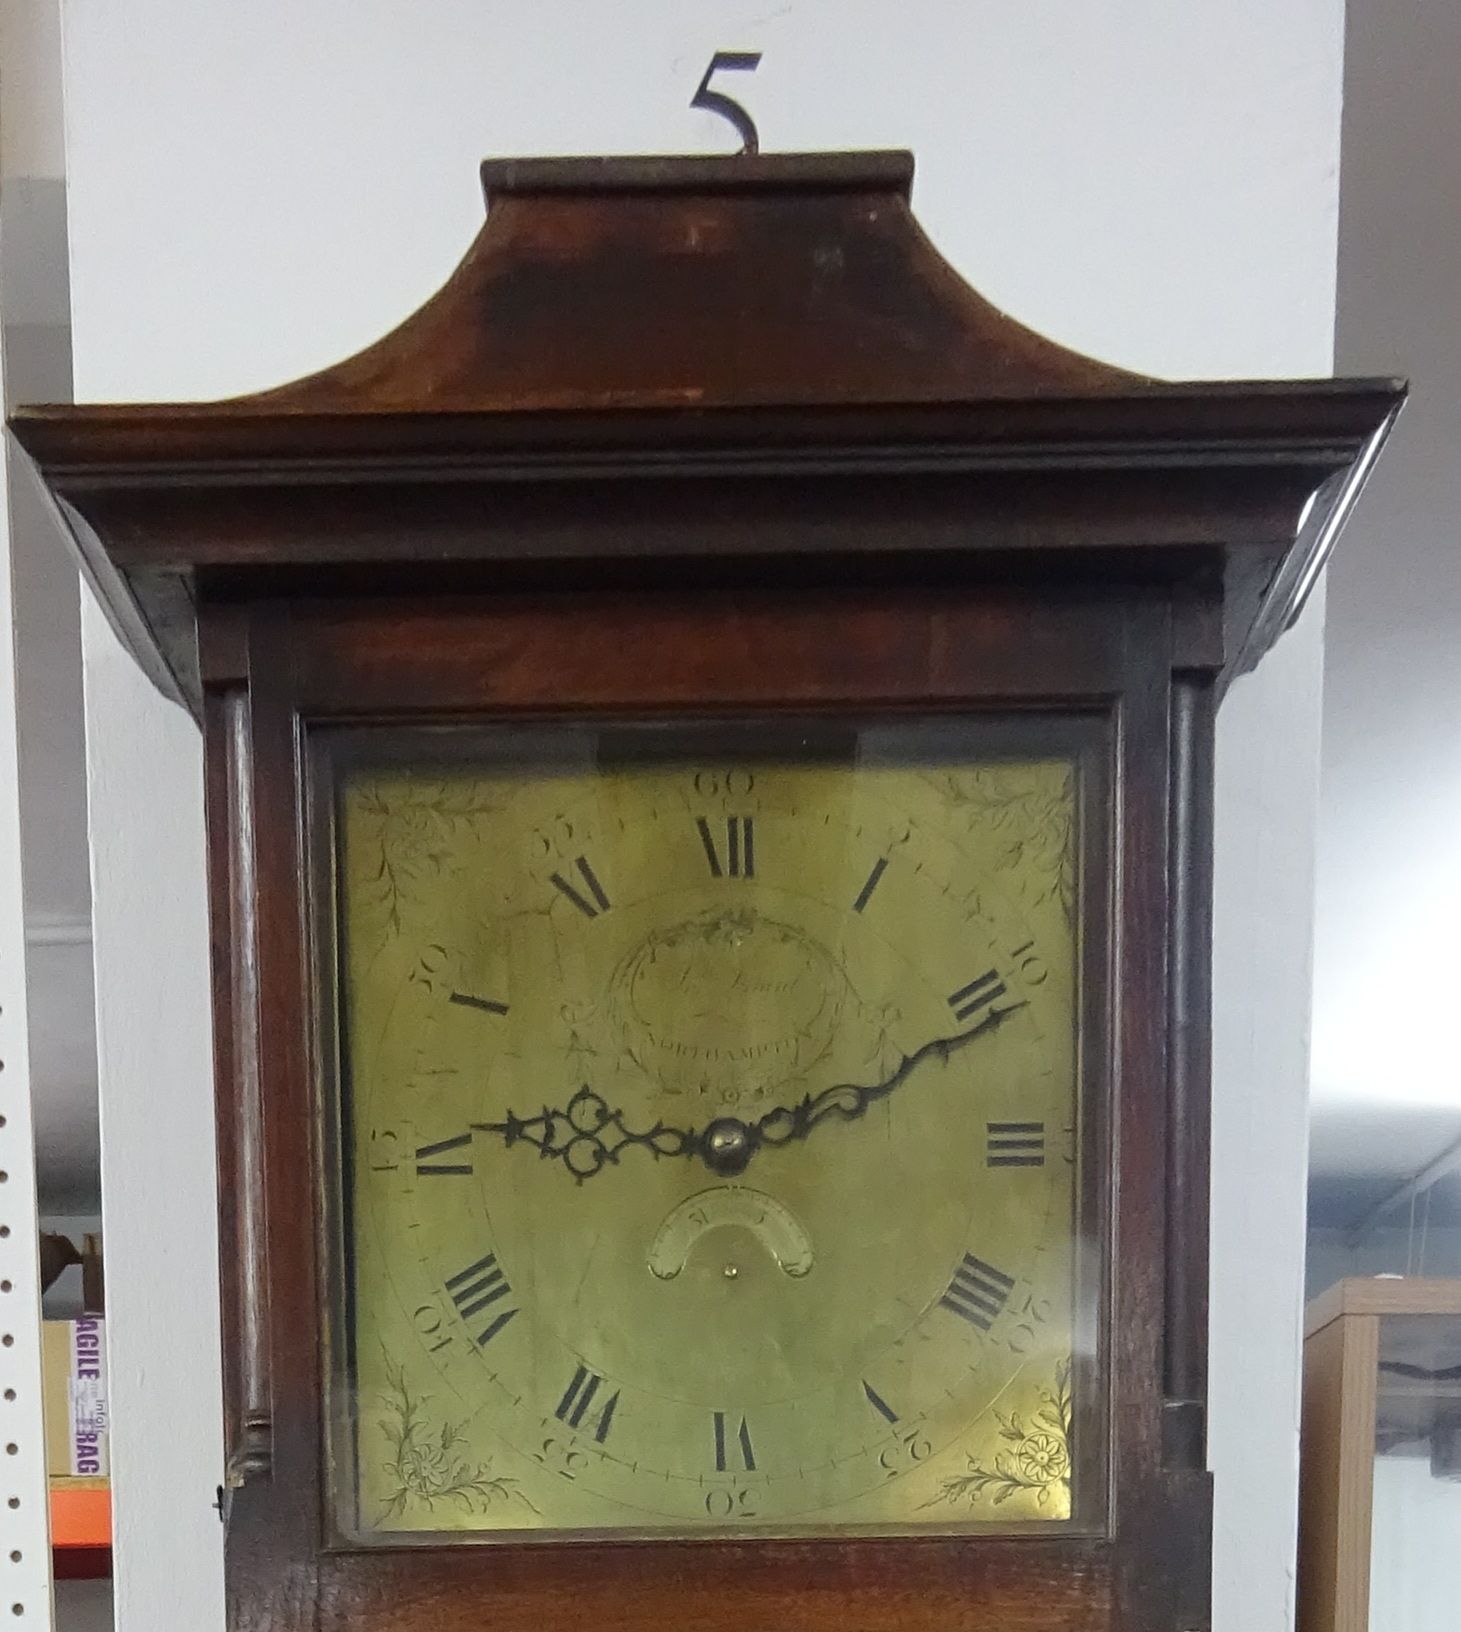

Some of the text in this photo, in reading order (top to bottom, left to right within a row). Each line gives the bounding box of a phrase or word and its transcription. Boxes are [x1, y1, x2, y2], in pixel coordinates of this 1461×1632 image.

[689, 51, 763, 154] 5
[1010, 940, 1048, 986] 10
[985, 1122, 1045, 1168] III
[940, 1251, 1016, 1331] IIII
